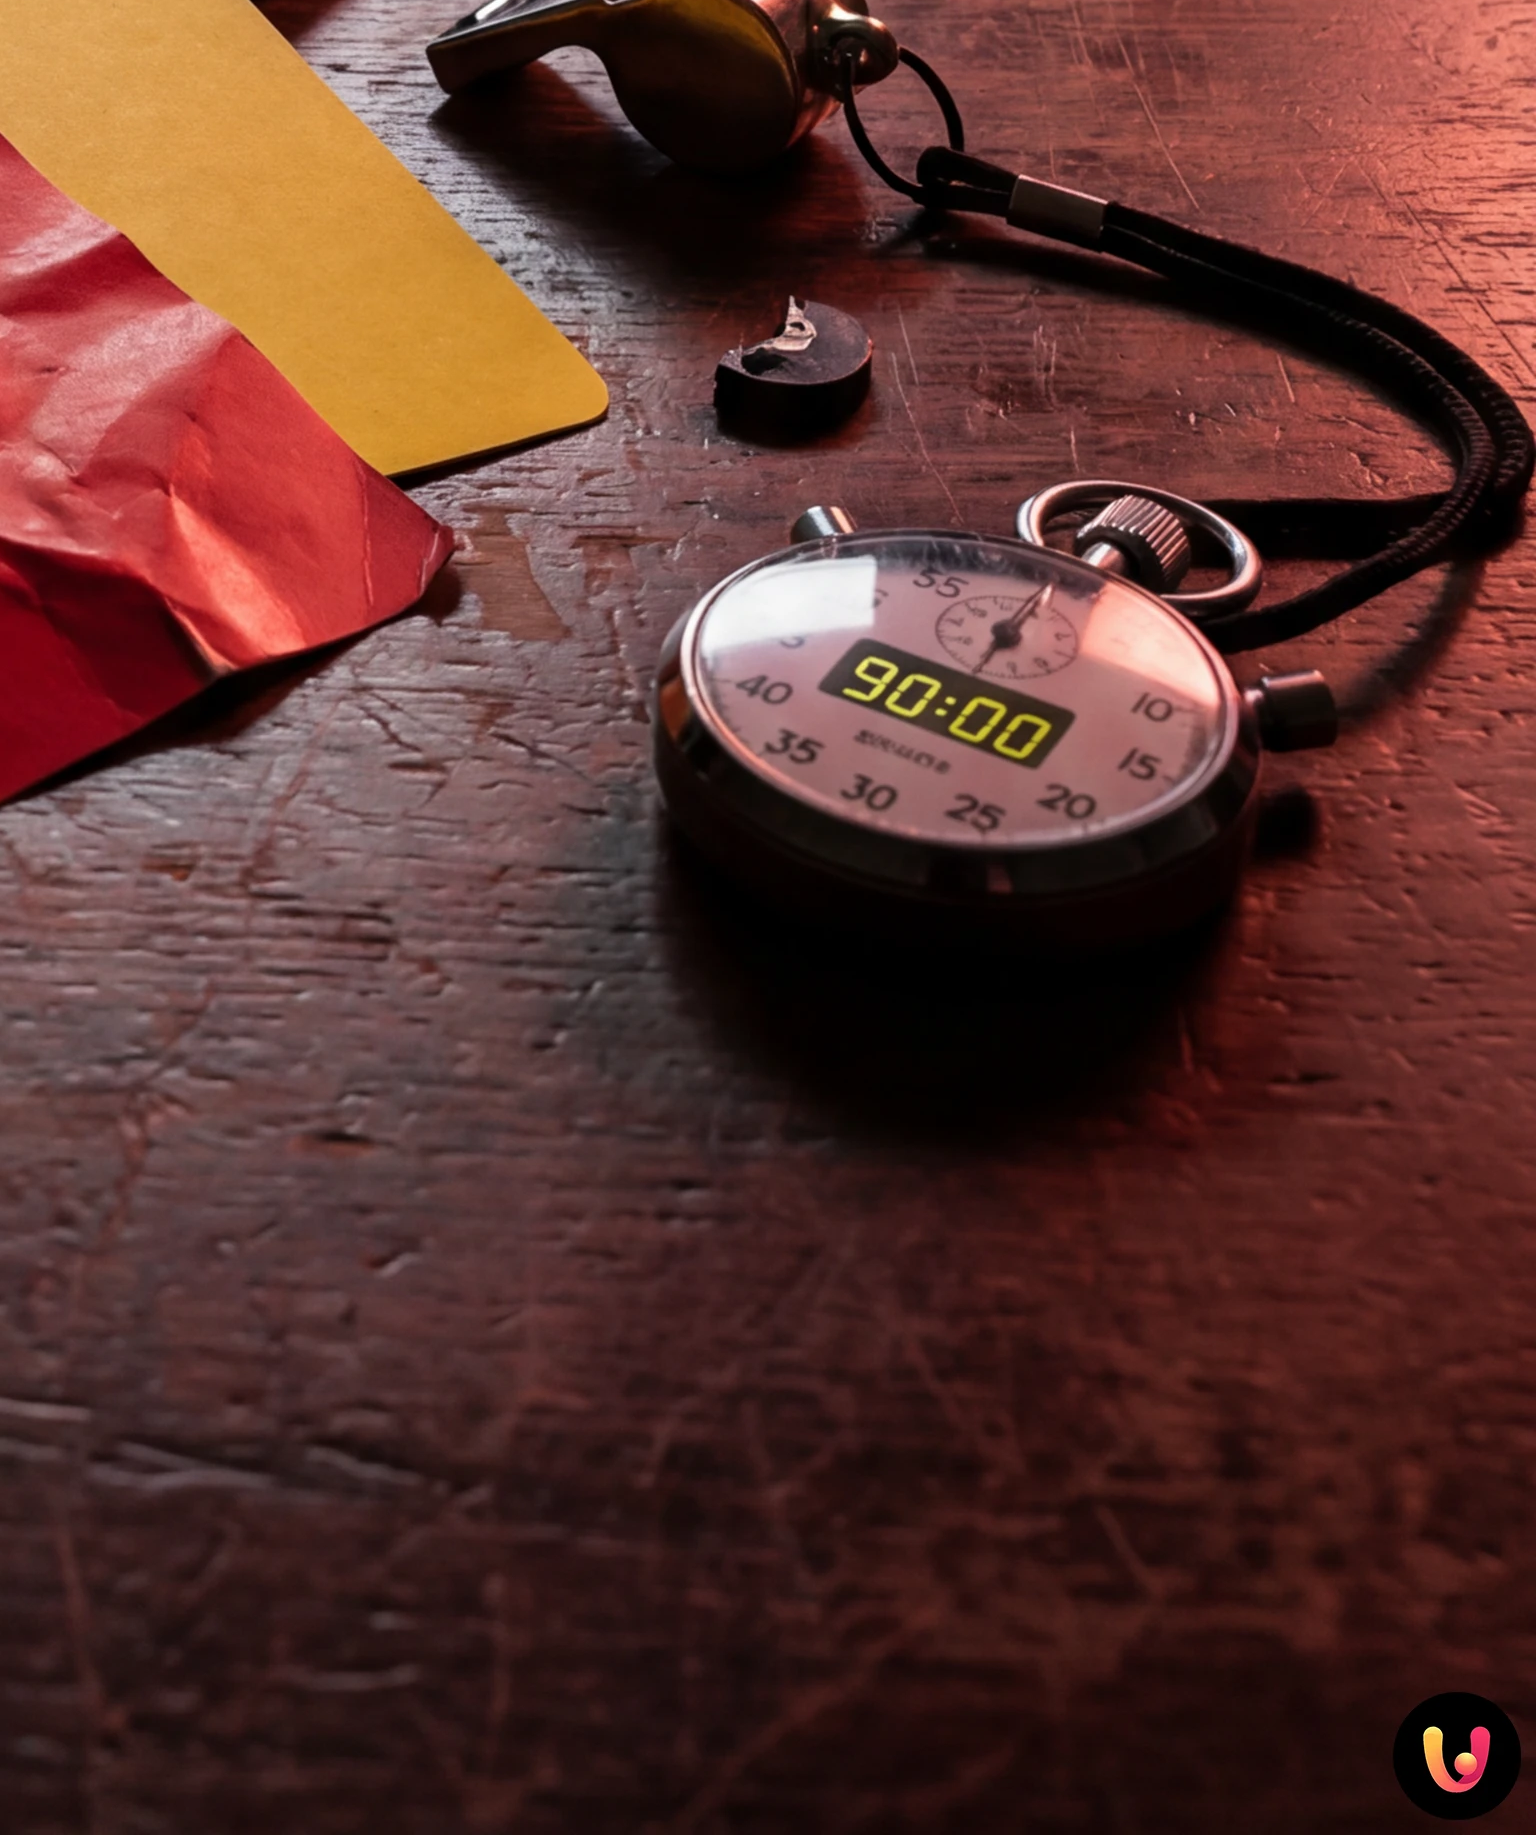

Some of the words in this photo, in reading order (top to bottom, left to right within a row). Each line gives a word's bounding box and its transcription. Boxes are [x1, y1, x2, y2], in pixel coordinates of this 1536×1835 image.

[913, 566, 970, 599] 55
[734, 674, 795, 706] 40
[842, 656, 1053, 760] 90:00
[1130, 691, 1174, 723] 10
[764, 728, 827, 765] 35
[1116, 747, 1163, 781] 15
[838, 772, 899, 813] 30
[1035, 782, 1098, 821] 20
[943, 792, 1008, 832] 25
